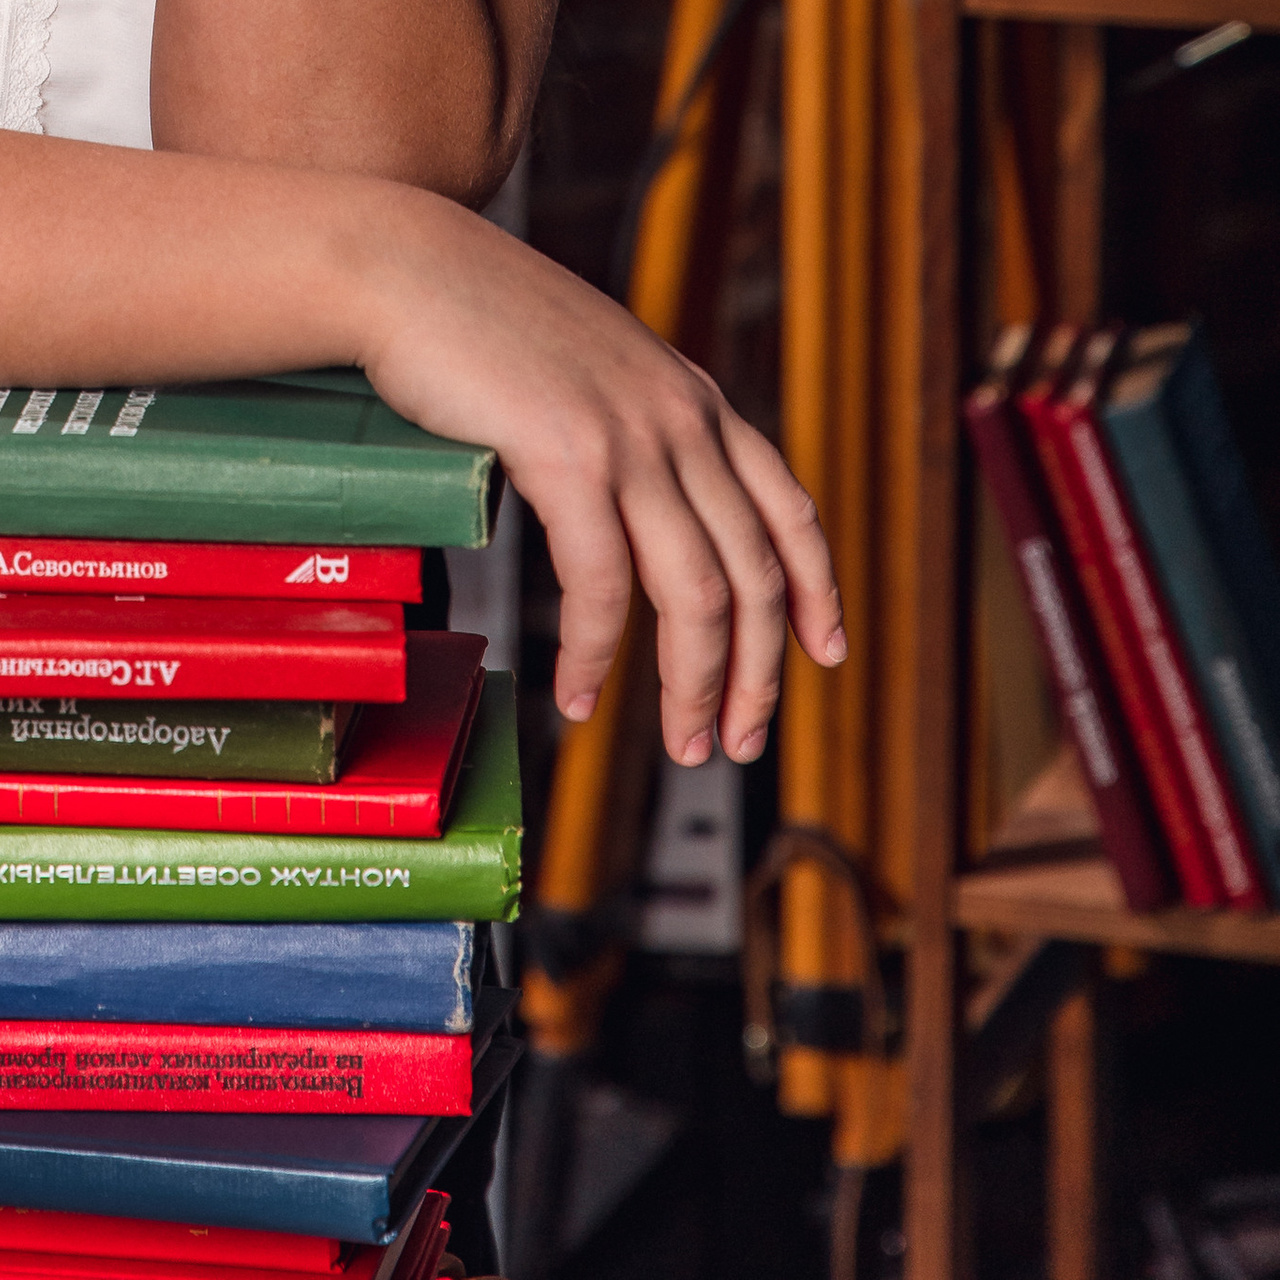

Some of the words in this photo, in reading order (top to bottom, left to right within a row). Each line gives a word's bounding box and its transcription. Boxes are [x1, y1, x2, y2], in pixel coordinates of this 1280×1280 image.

[11, 713, 231, 756] Лабораторный
[271, 865, 411, 888] МОНТАЖ
[76, 1051, 152, 1069] легкой
[161, 1048, 328, 1070] предприятиях
[336, 1053, 364, 1069] на
[216, 1072, 364, 1098] Вентиляция,
